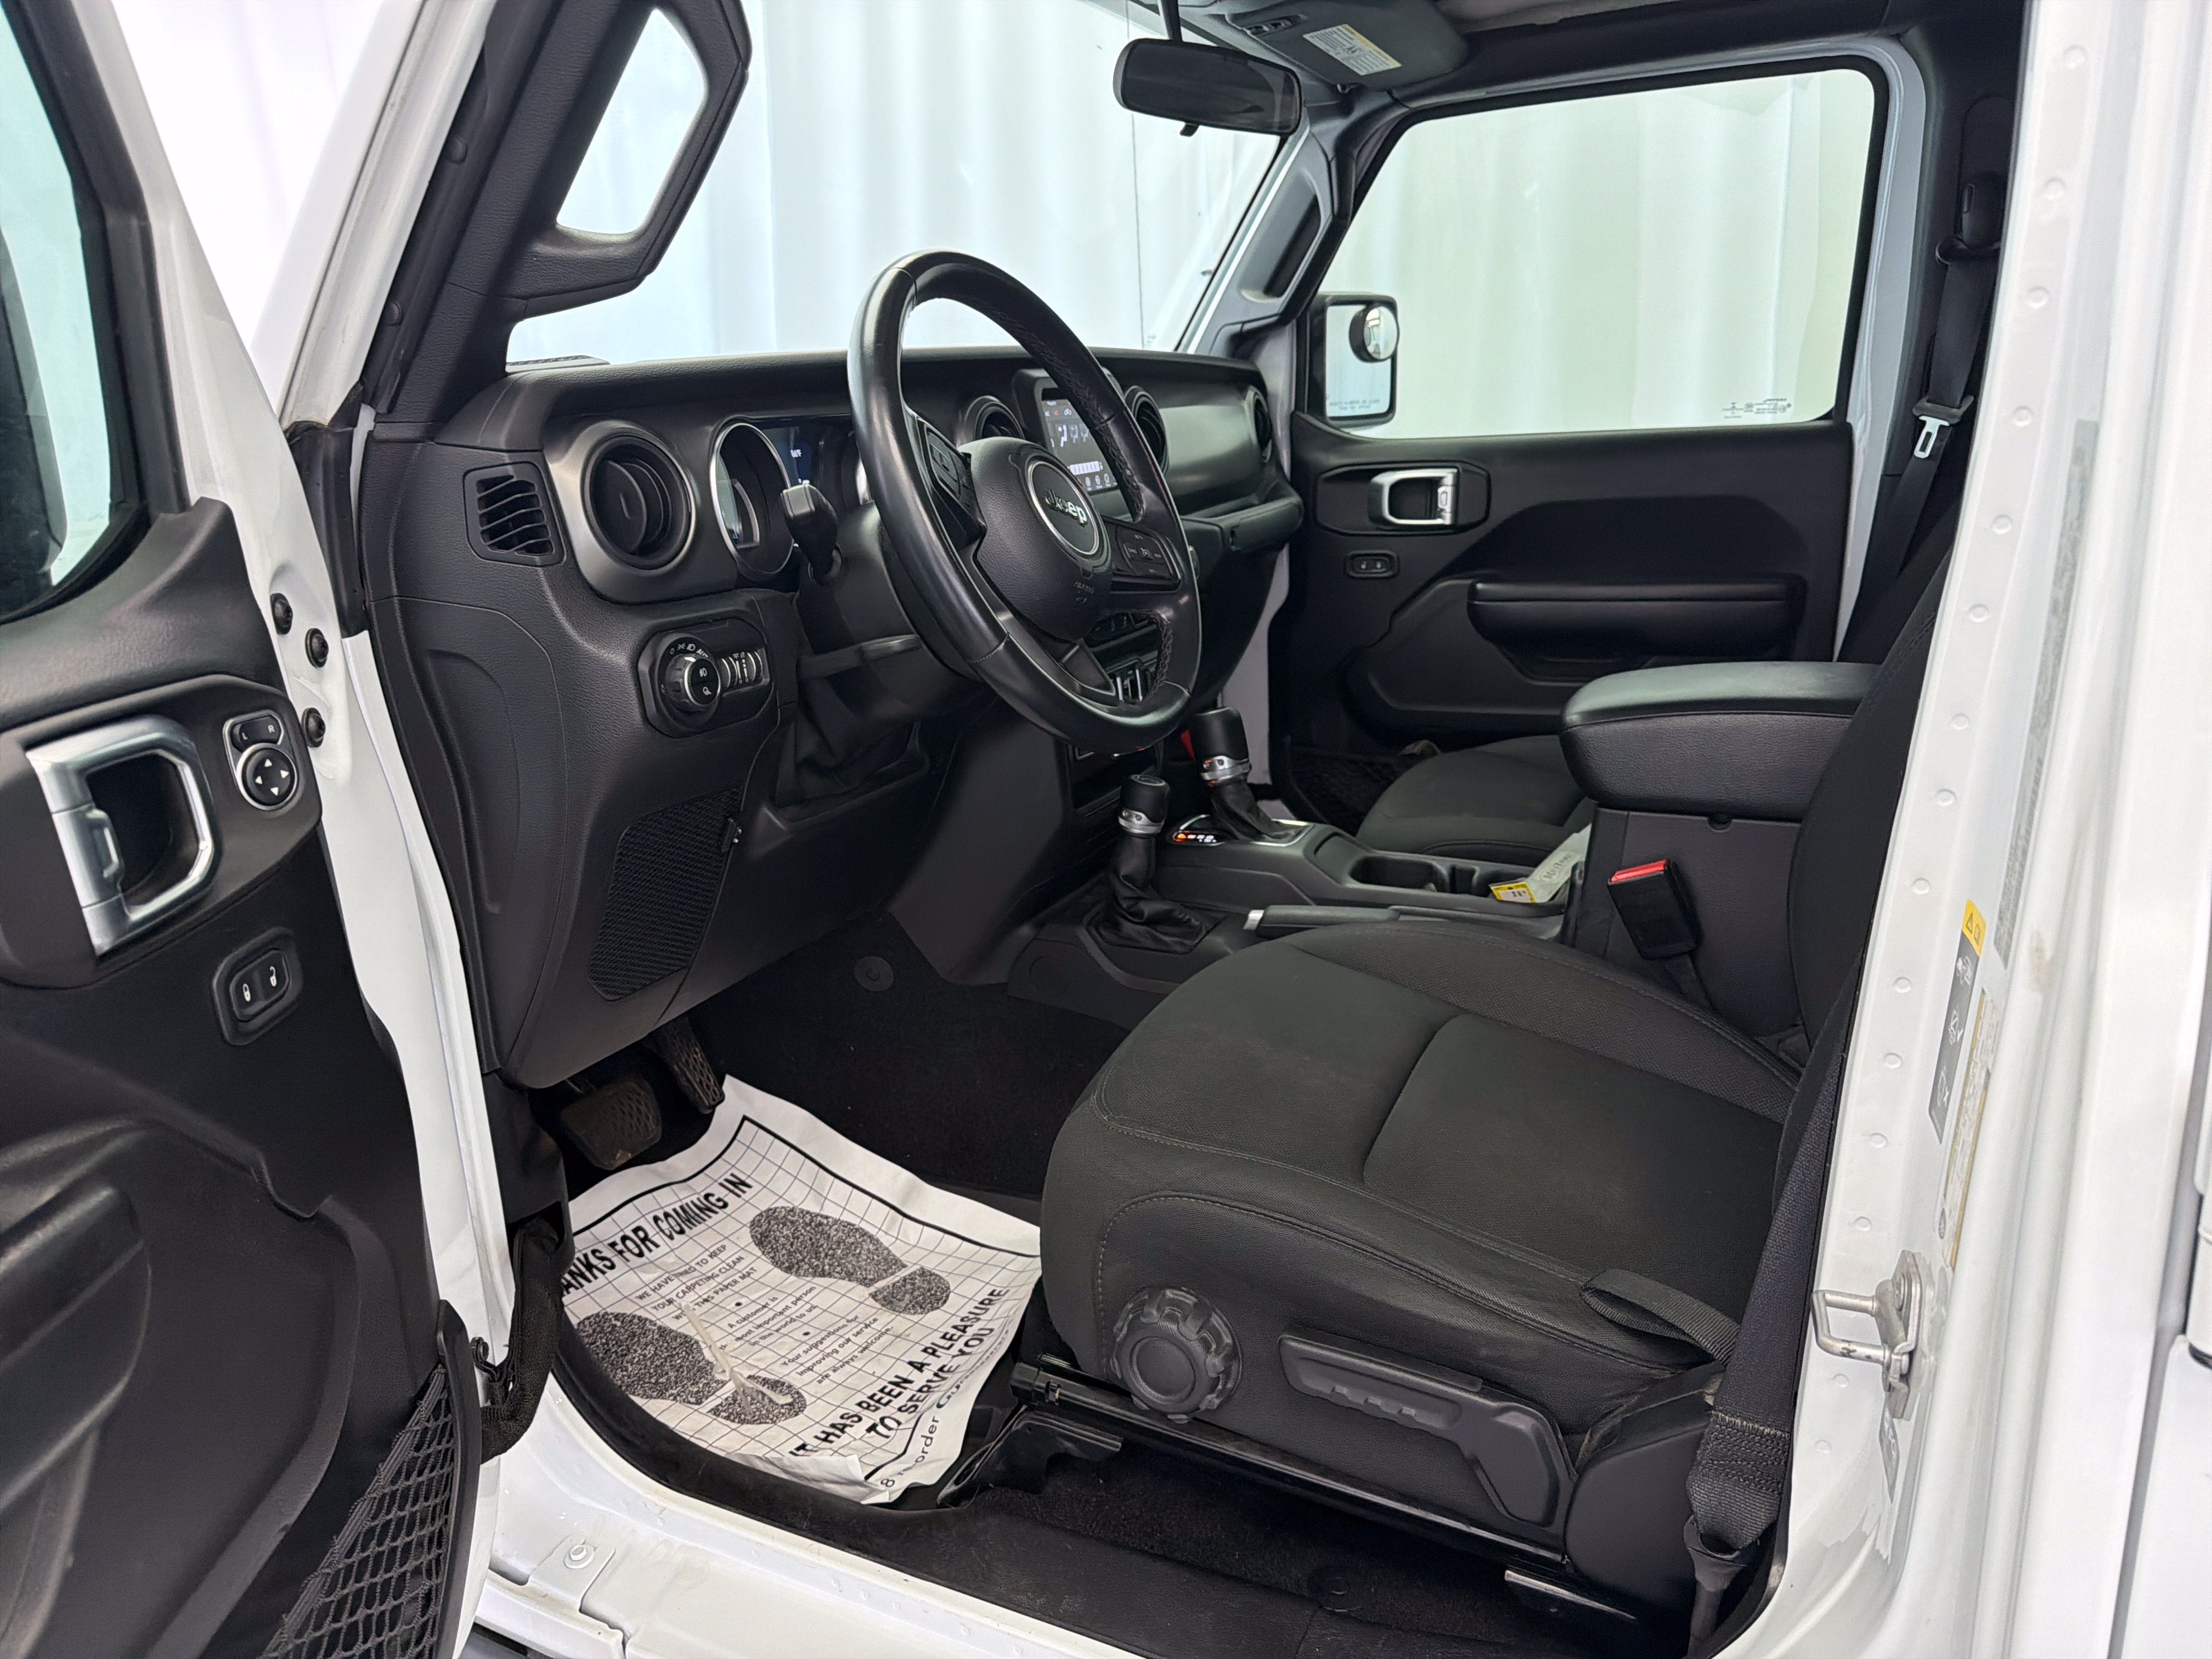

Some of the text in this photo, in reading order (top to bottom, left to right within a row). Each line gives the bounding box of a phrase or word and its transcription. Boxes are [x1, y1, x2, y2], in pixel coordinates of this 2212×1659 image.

[1045, 487, 1088, 527] Jeep
[241, 731, 249, 740] L
[268, 725, 275, 733] R
[561, 1173, 753, 1295] ANKS FOR COMING IN
[636, 1290, 652, 1300] WE
[653, 1273, 675, 1293] HAVE
[695, 1258, 709, 1268] TO
[708, 1244, 727, 1259] KEEP
[651, 1255, 744, 1311] YOUR CARPETING CLEAN
[693, 1295, 715, 1307] THIS
[713, 1279, 740, 1295] PAPER
[739, 1267, 758, 1280] MAT
[735, 1329, 755, 1342] most
[752, 1305, 792, 1330] important
[791, 1286, 817, 1306] person
[736, 1301, 770, 1324] customer
[774, 1317, 797, 1333] world
[838, 1336, 853, 1348] our
[851, 1317, 879, 1338] service
[780, 1315, 860, 1366] Your suggestions for
[816, 1326, 894, 1384] are always welcome.
[788, 1441, 820, 1457] IT
[812, 1411, 864, 1444] HAS
[854, 1374, 915, 1413] BEEN
[906, 1359, 932, 1374] A
[920, 1288, 1011, 1359] PLEASURE
[865, 1415, 903, 1440] TO
[897, 1363, 962, 1415] SERVE
[951, 1327, 996, 1359] YOU
[880, 1478, 895, 1488] 8
